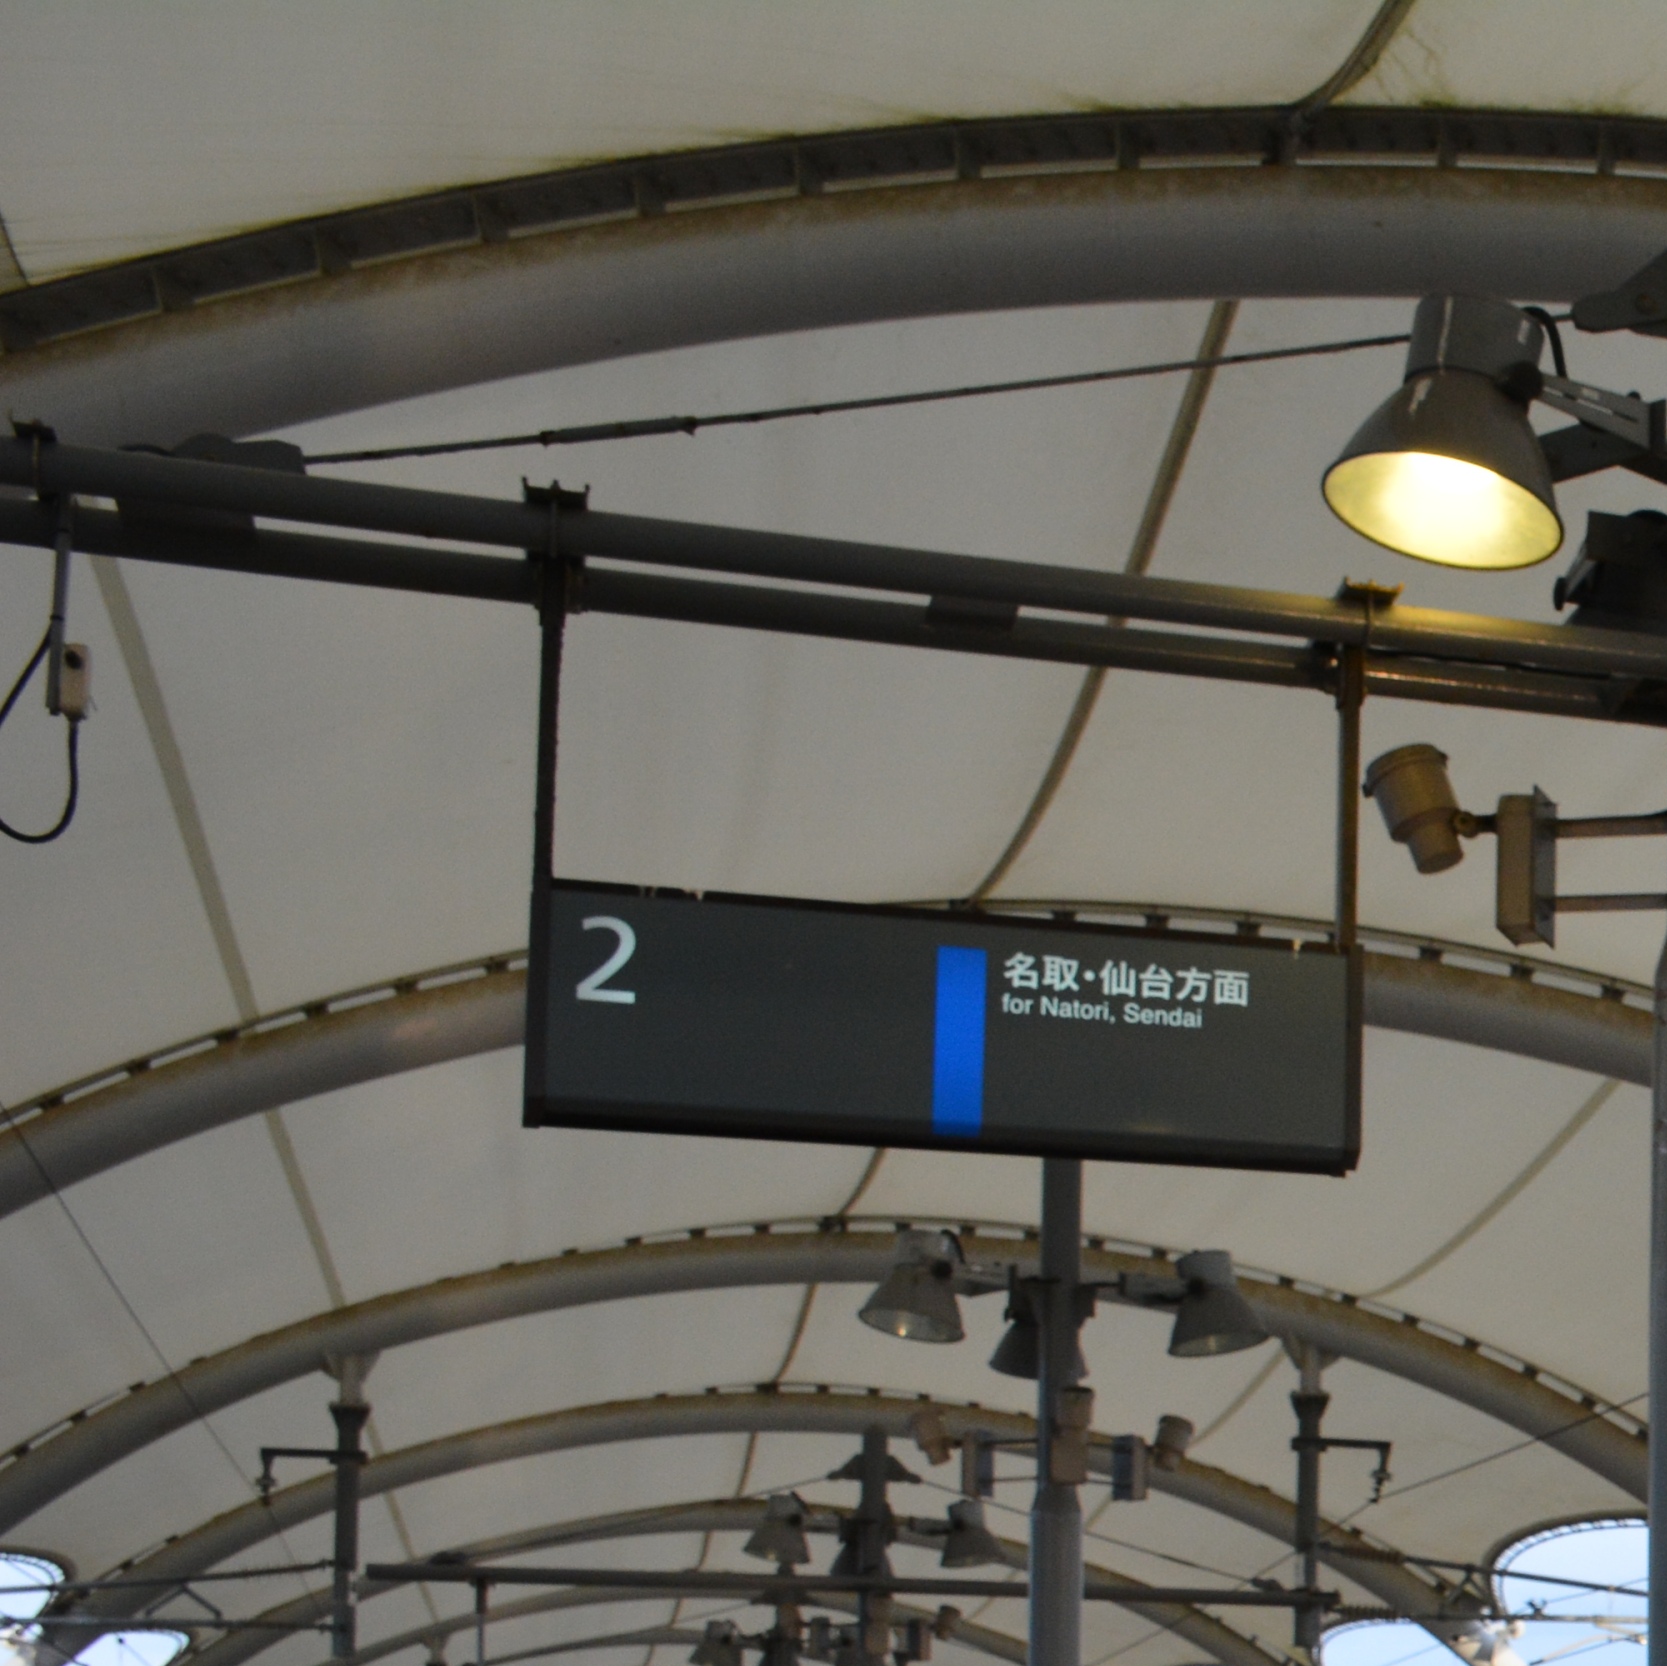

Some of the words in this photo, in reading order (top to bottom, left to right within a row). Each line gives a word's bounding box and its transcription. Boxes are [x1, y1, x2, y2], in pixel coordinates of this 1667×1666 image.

[576, 914, 637, 1005] 2
[1003, 951, 1250, 1008] 名取・仙台方面
[1001, 992, 1035, 1015] for
[1039, 996, 1117, 1025] Natori,
[1123, 1002, 1203, 1029] Sendai
